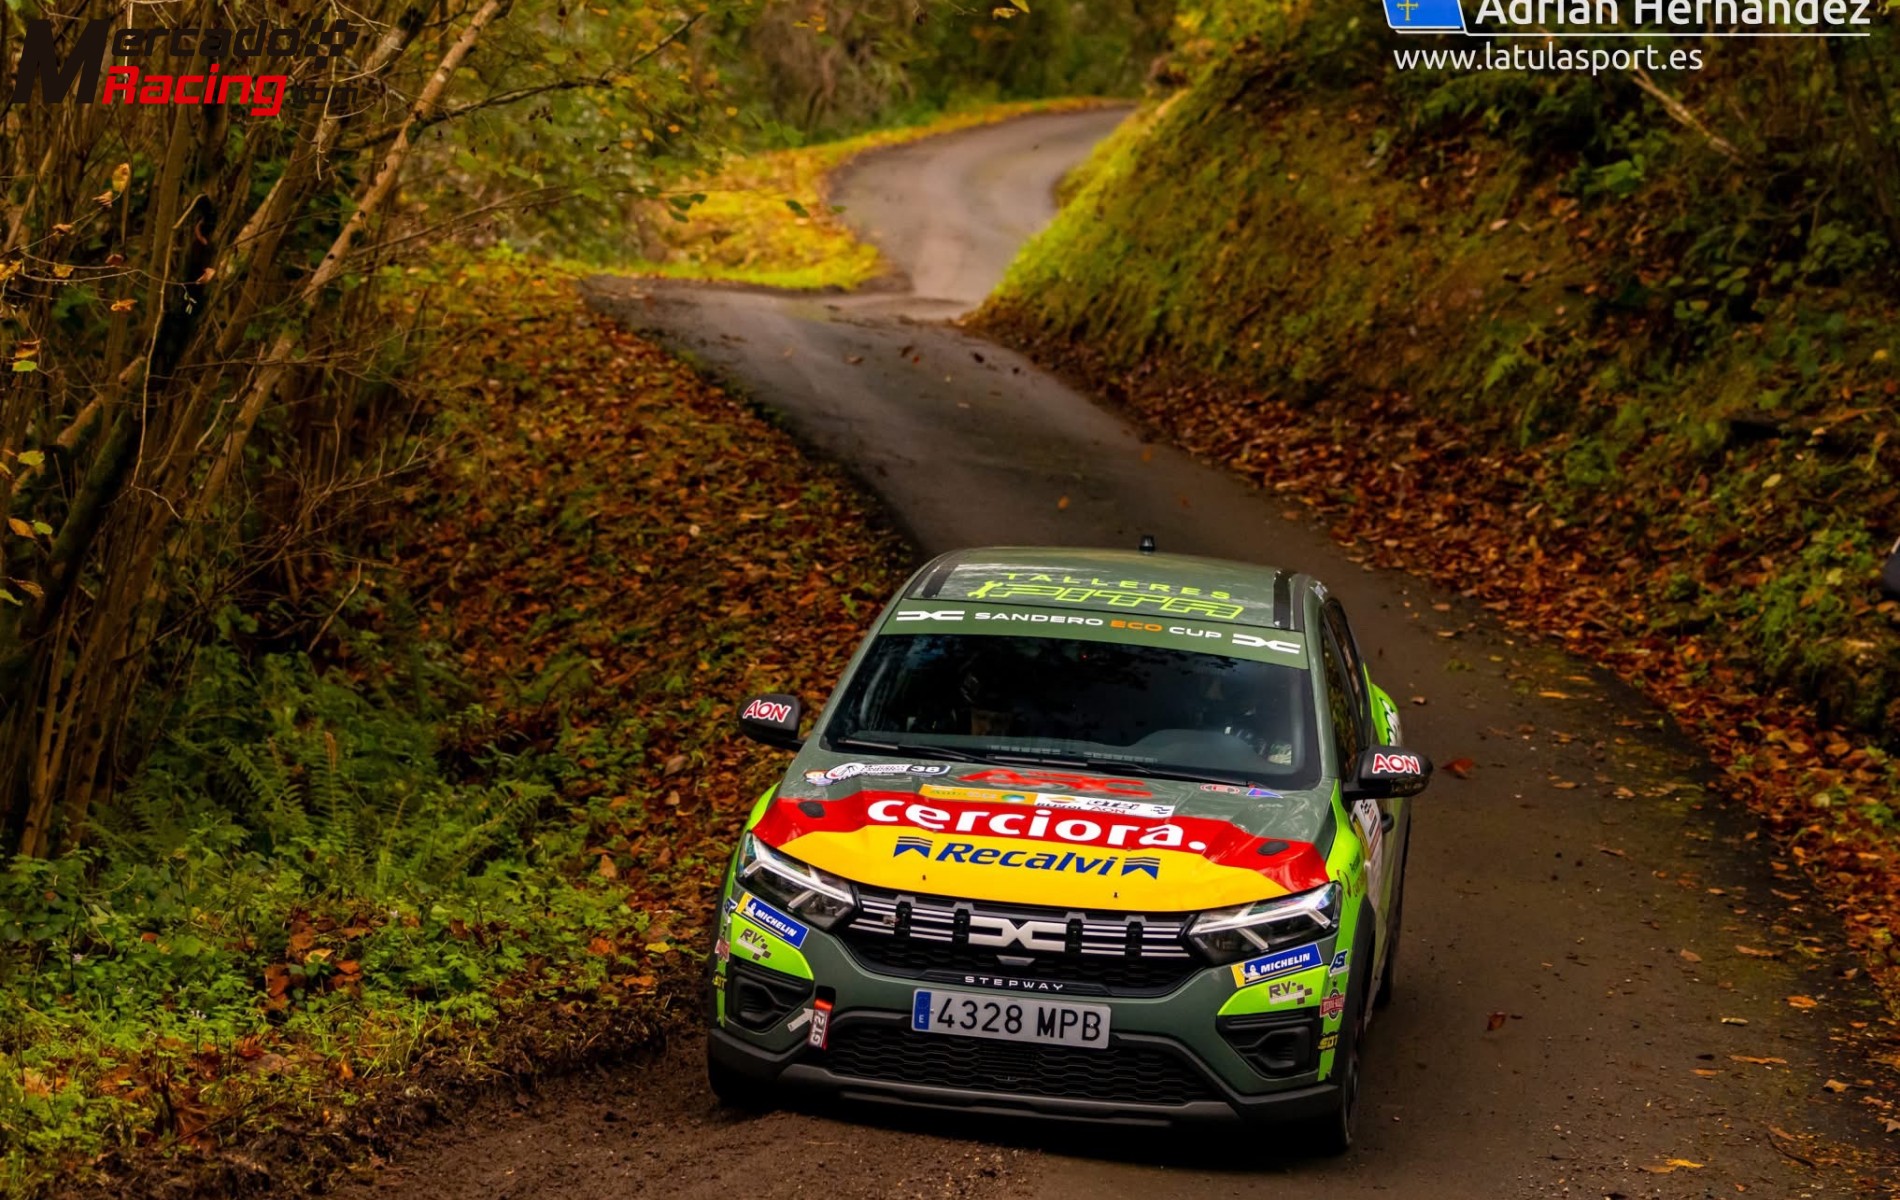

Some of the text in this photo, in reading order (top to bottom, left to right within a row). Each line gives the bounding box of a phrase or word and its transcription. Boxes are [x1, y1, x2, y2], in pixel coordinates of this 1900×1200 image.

[1006, 573, 1231, 600] TALLERES
[989, 584, 1245, 619] PITA
[974, 612, 1223, 640] SANDERO ECO CUP
[742, 699, 791, 723] AON
[908, 763, 942, 776] 38
[1372, 754, 1421, 775] AON
[867, 799, 1206, 851] cerciora.
[935, 842, 1118, 876] Recalvi
[755, 908, 798, 938] MICHELIN
[1260, 952, 1311, 974] MICHELIN
[964, 975, 1065, 991] STEPWAY
[936, 997, 1102, 1042] 4328 MPB
